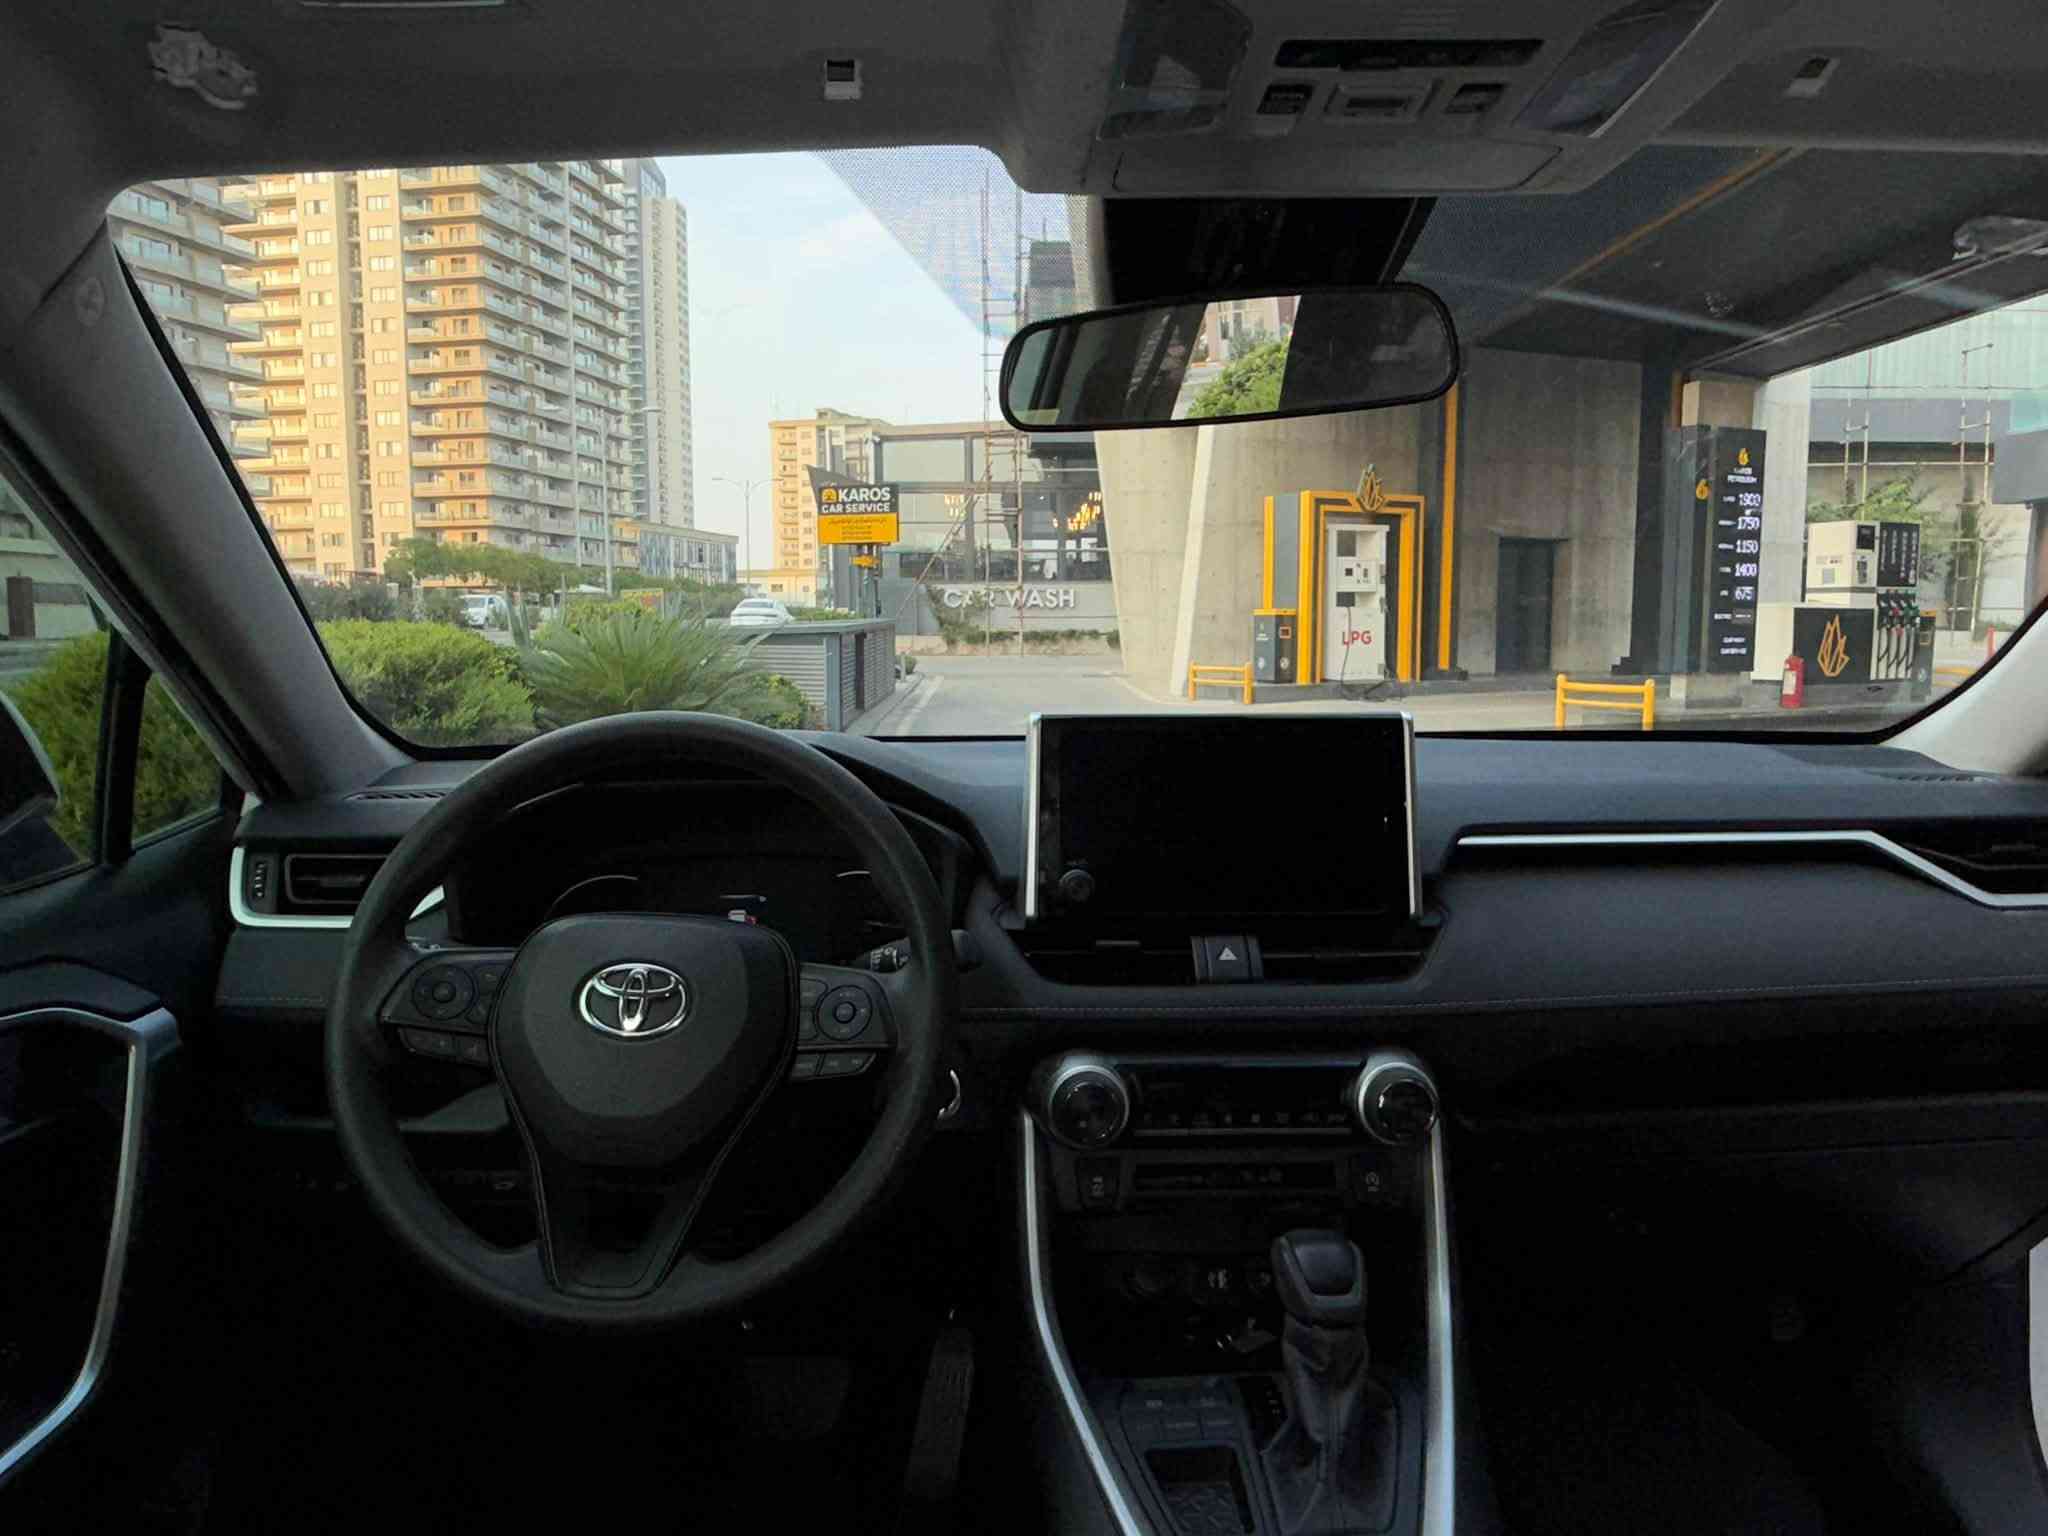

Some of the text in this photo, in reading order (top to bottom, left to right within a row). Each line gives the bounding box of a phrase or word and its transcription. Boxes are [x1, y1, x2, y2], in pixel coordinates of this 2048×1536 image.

[838, 487, 891, 502] KAROS
[822, 502, 891, 513] CAR SERVICE
[1737, 516, 1760, 530] 1750
[1736, 539, 1759, 554] 1150
[1734, 562, 1758, 577] 1400
[943, 588, 1075, 608] CAR WASH
[1342, 631, 1372, 645] LPG
